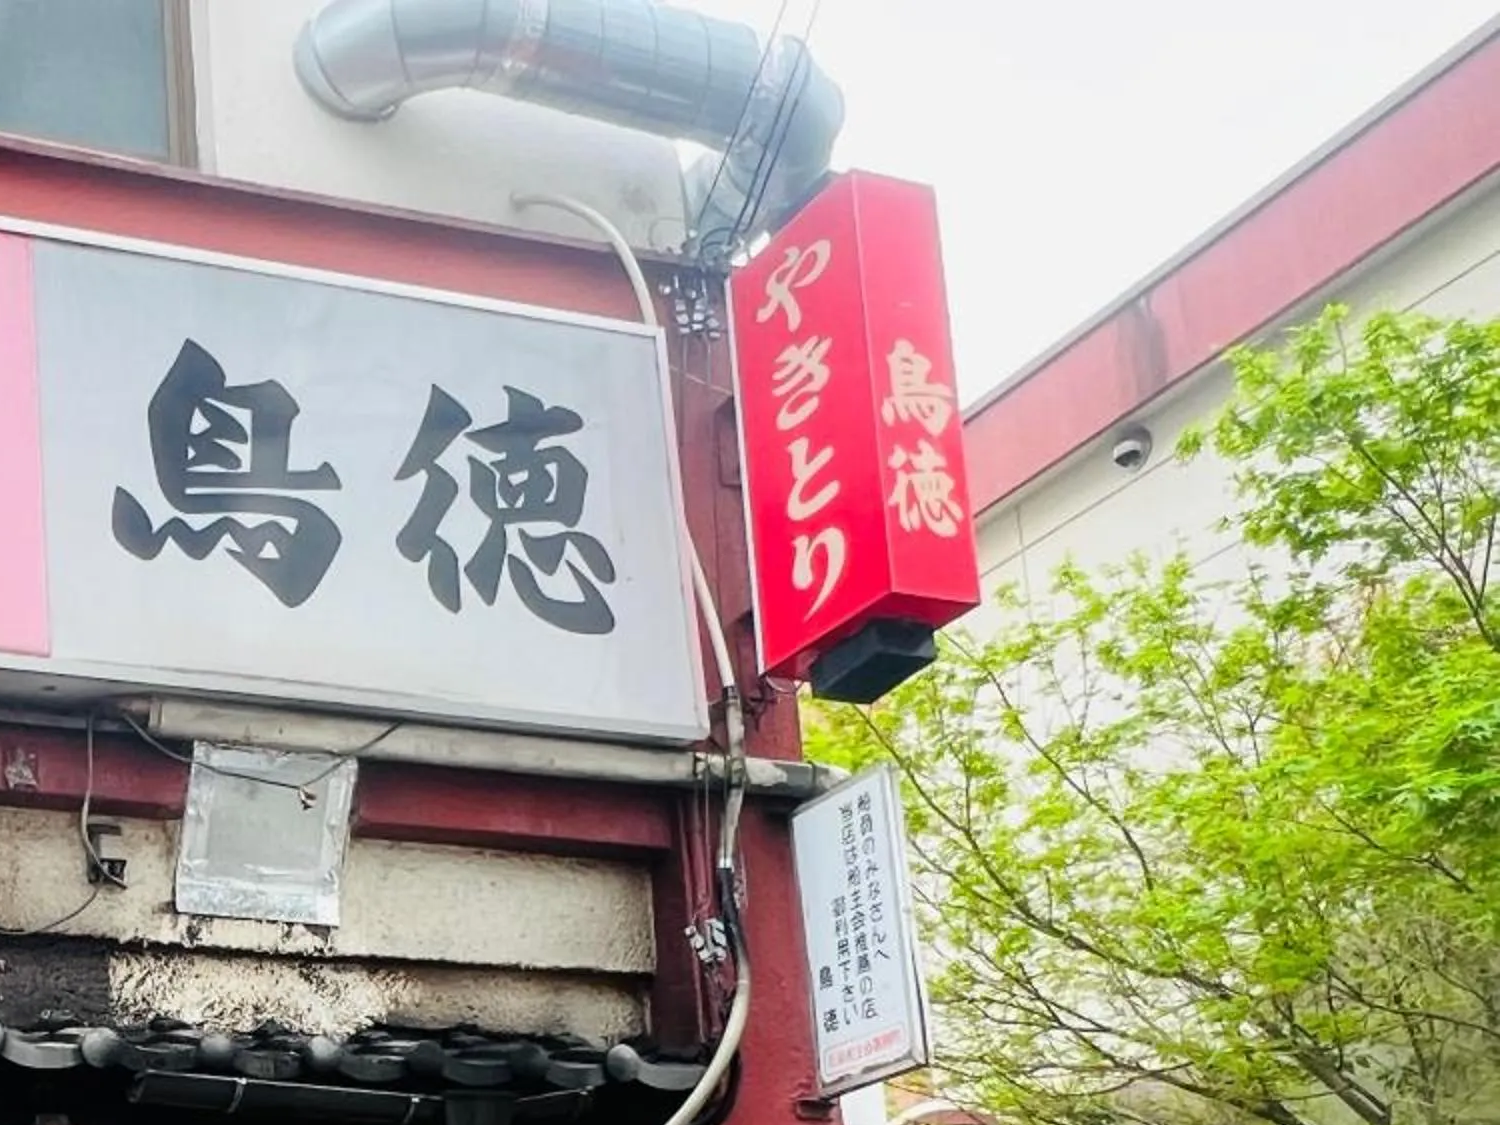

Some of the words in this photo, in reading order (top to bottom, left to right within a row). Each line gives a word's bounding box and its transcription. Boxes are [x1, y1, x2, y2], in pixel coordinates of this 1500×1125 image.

[112, 338, 616, 635] 鳥徳
[756, 239, 846, 622] やきとり
[882, 338, 964, 538] 鳥徳
